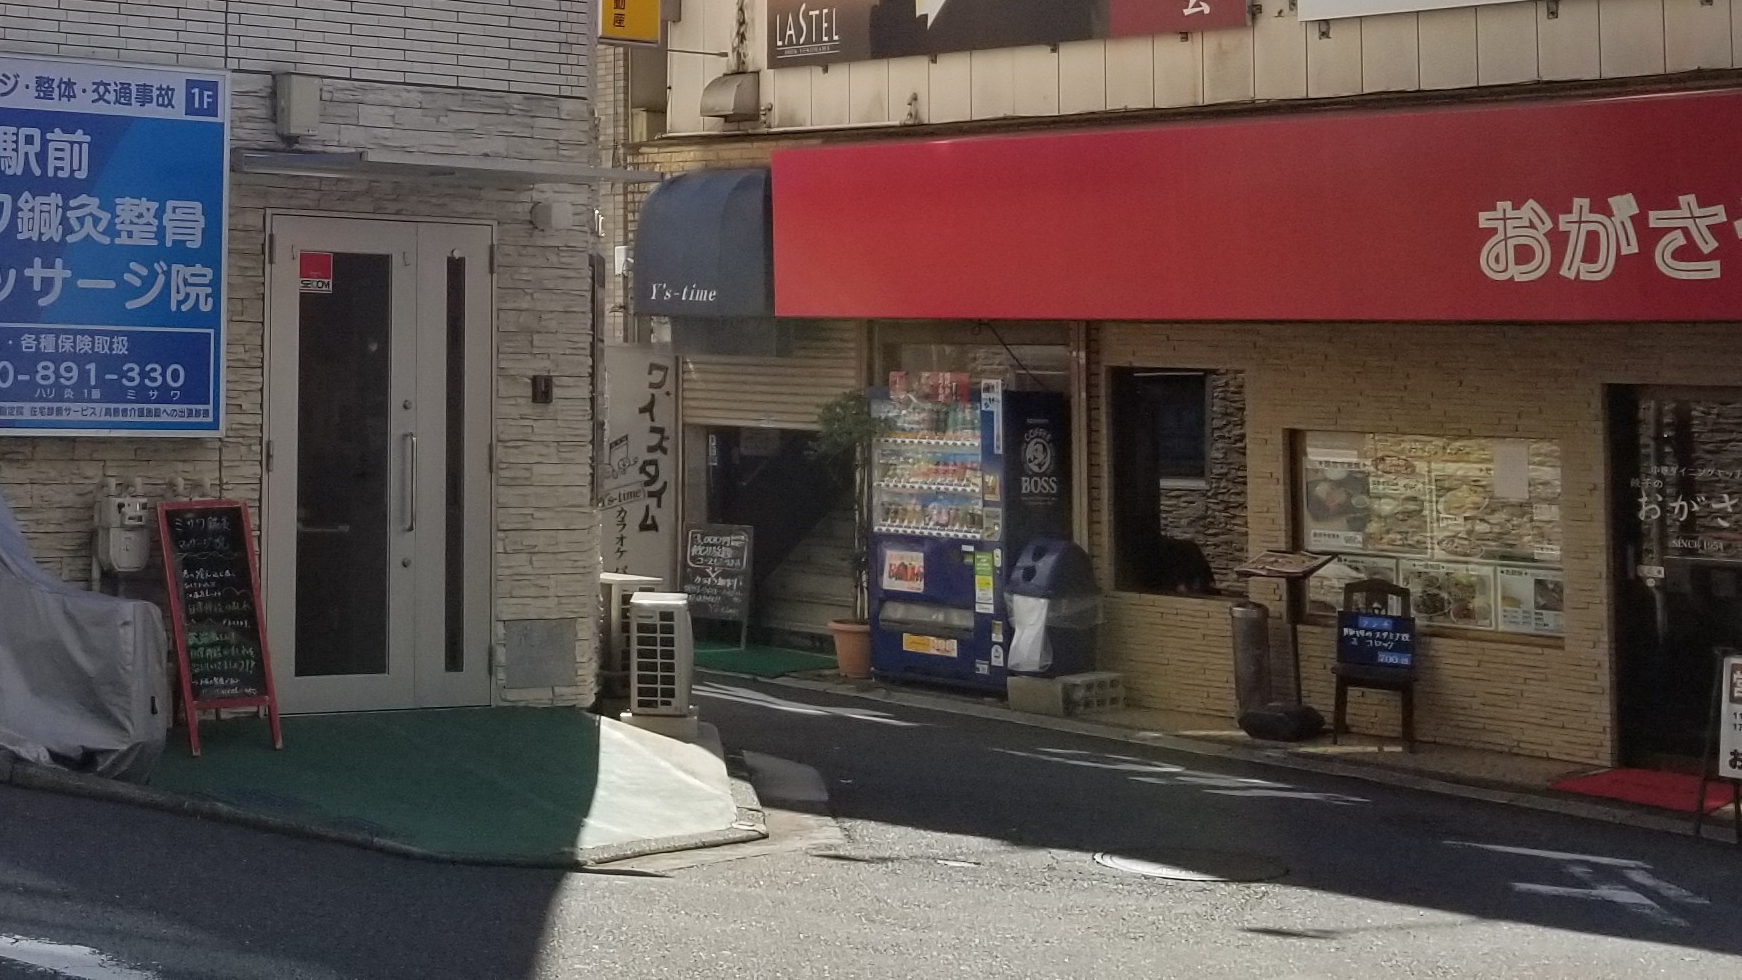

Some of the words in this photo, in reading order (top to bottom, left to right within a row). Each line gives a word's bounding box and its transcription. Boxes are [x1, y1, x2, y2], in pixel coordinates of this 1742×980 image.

[776, 2, 840, 47] LASTEL
[189, 86, 214, 110] 1F
[1478, 192, 1742, 282] おがさ
[300, 279, 331, 290] SECOM
[1021, 476, 1058, 494] BOSS
[614, 506, 628, 560] カラオケ
